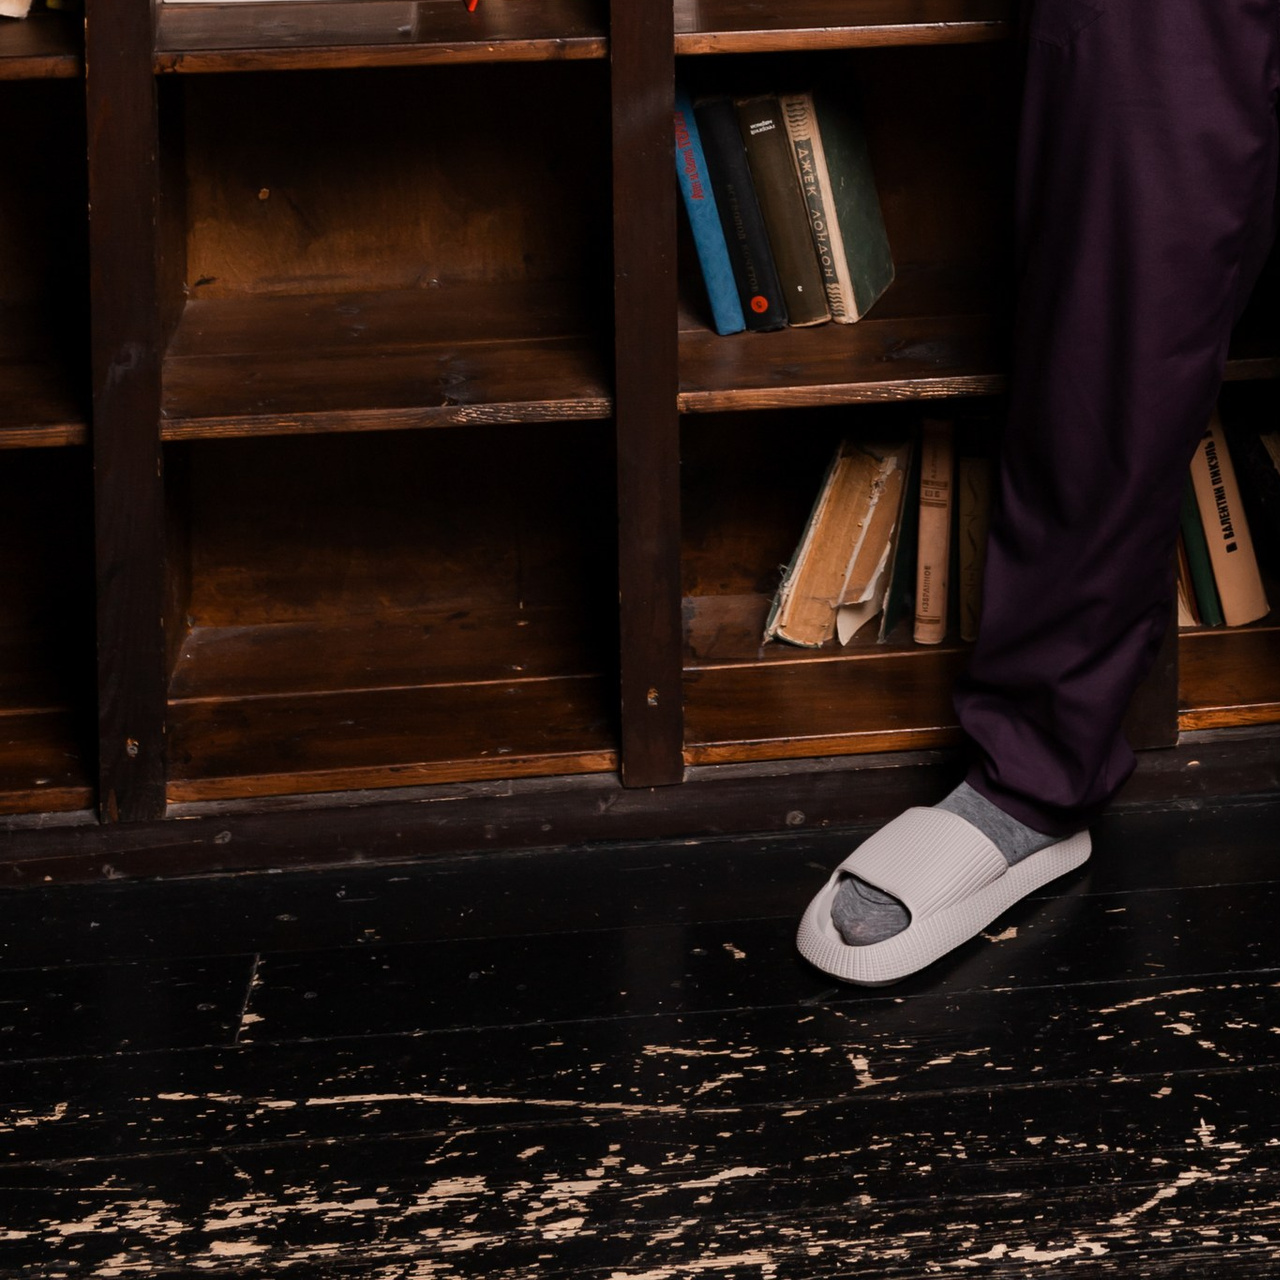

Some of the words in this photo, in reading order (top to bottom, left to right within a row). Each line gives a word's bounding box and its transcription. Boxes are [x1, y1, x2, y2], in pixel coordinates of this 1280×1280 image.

[795, 146, 818, 198] ДЖЕК
[808, 208, 837, 281] ЛОНДОН
[1203, 439, 1223, 485] ПИКУЛЬ
[1212, 484, 1234, 539] ВАЛЕНТИН
[918, 564, 934, 612] ИЗБРАННОЕ
